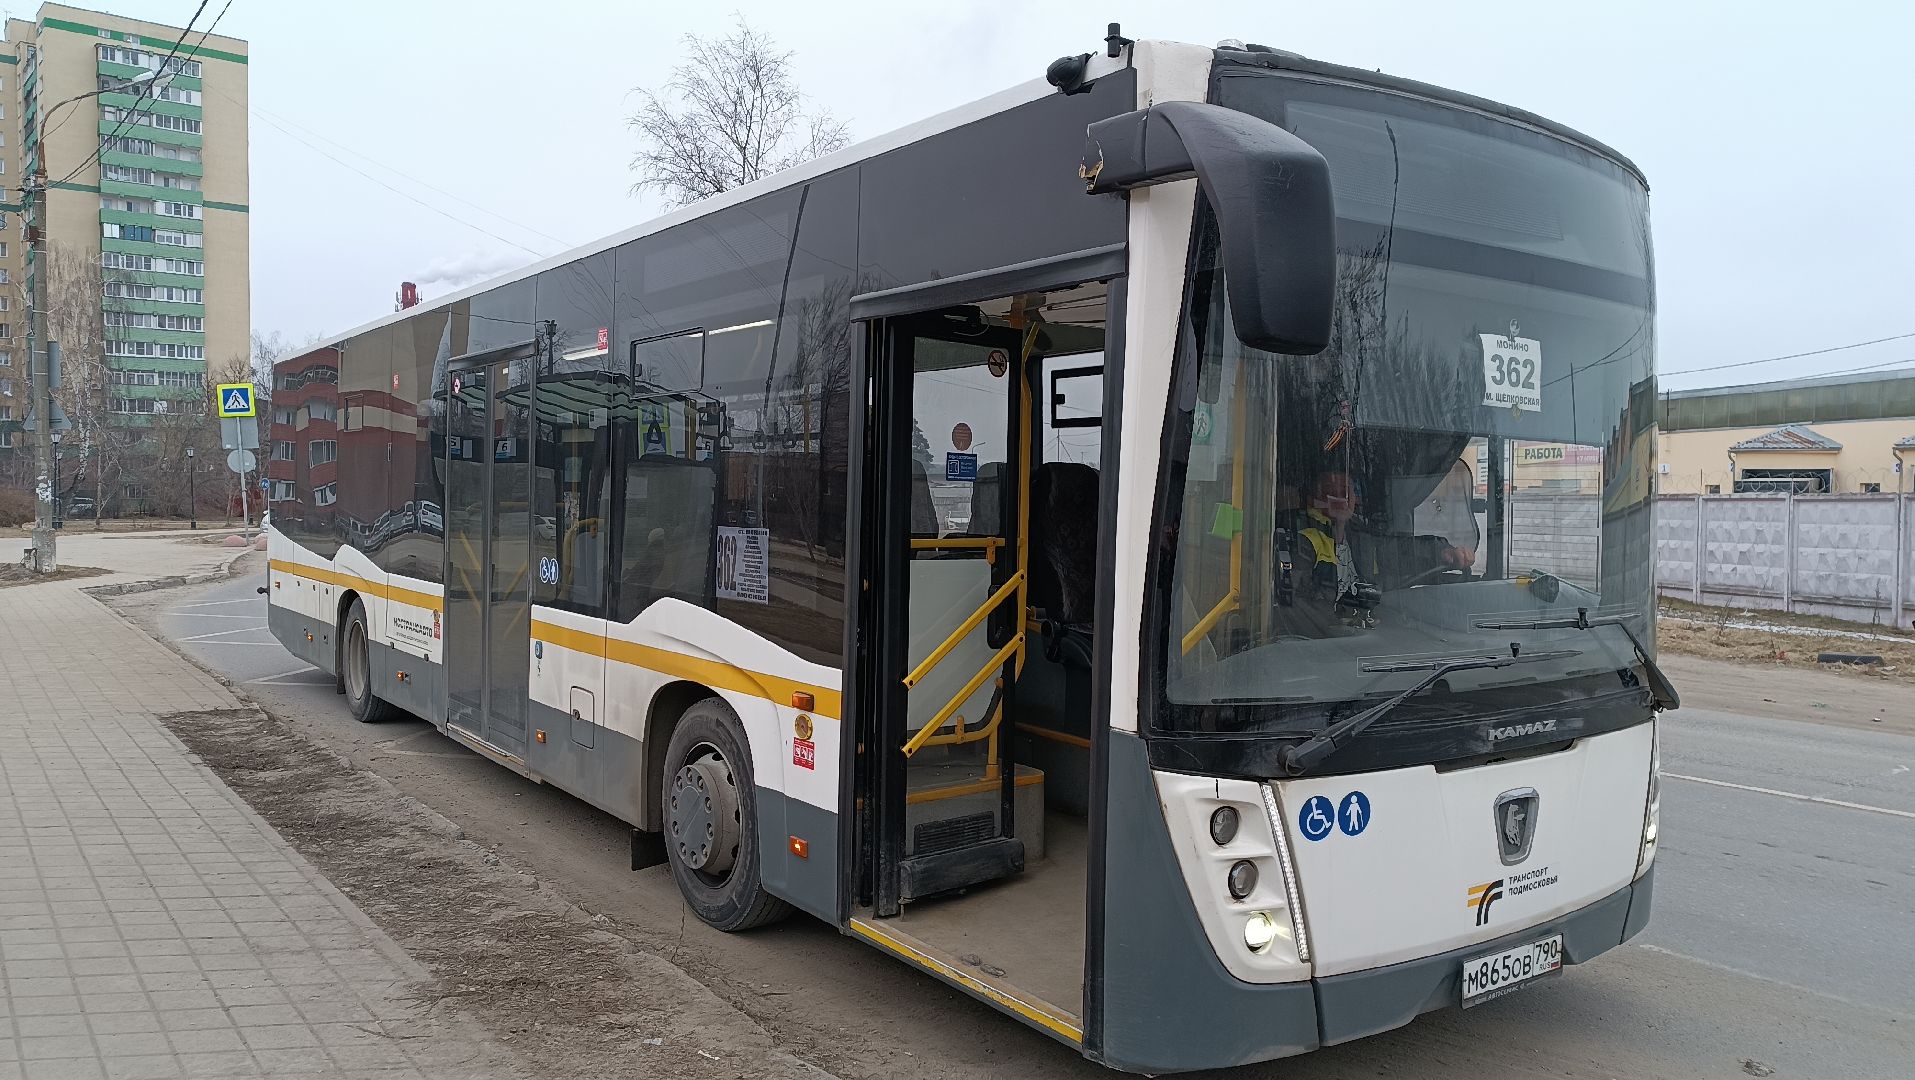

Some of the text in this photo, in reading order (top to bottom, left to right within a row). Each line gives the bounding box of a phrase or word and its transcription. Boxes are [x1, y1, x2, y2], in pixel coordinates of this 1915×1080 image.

[1496, 339, 1529, 353] МОНИНО
[1490, 353, 1535, 390] 362
[1495, 392, 1540, 407] ЩЕЛКОВСКАЯ
[1524, 447, 1564, 460] РАБОТА
[1895, 462, 1901, 473] 3
[717, 534, 738, 592] 362
[1488, 719, 1558, 741] KAMAZ
[1508, 866, 1549, 885] ТРАНСПОРТ
[1508, 875, 1558, 897] ПОДМОСКОВЬЯ
[1535, 939, 1558, 965] 790
[1539, 961, 1551, 971] RUS
